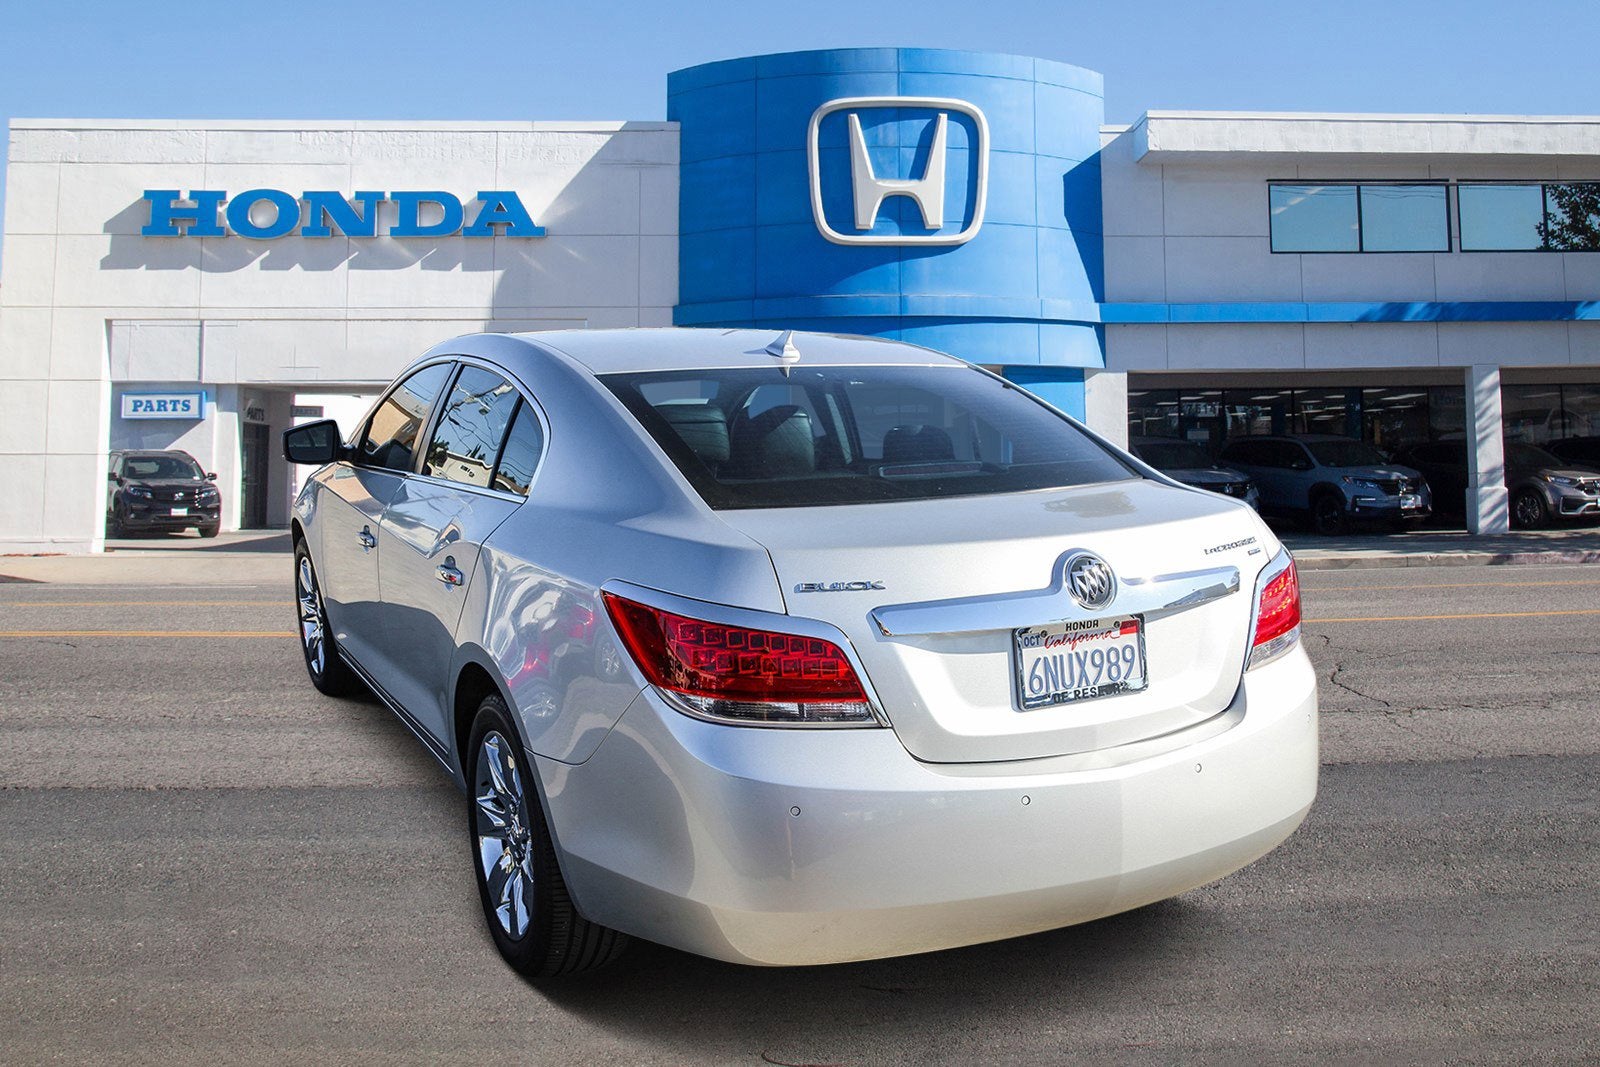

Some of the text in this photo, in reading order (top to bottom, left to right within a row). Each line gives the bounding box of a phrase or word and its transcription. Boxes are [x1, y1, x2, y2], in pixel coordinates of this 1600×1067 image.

[141, 188, 547, 239] HONDA
[132, 399, 191, 412] PARTS
[794, 580, 886, 593] BUICK
[1065, 619, 1099, 632] HONDA
[1023, 635, 1040, 647] OCT
[1044, 630, 1120, 651] California
[1029, 644, 1136, 694] 6NUX989
